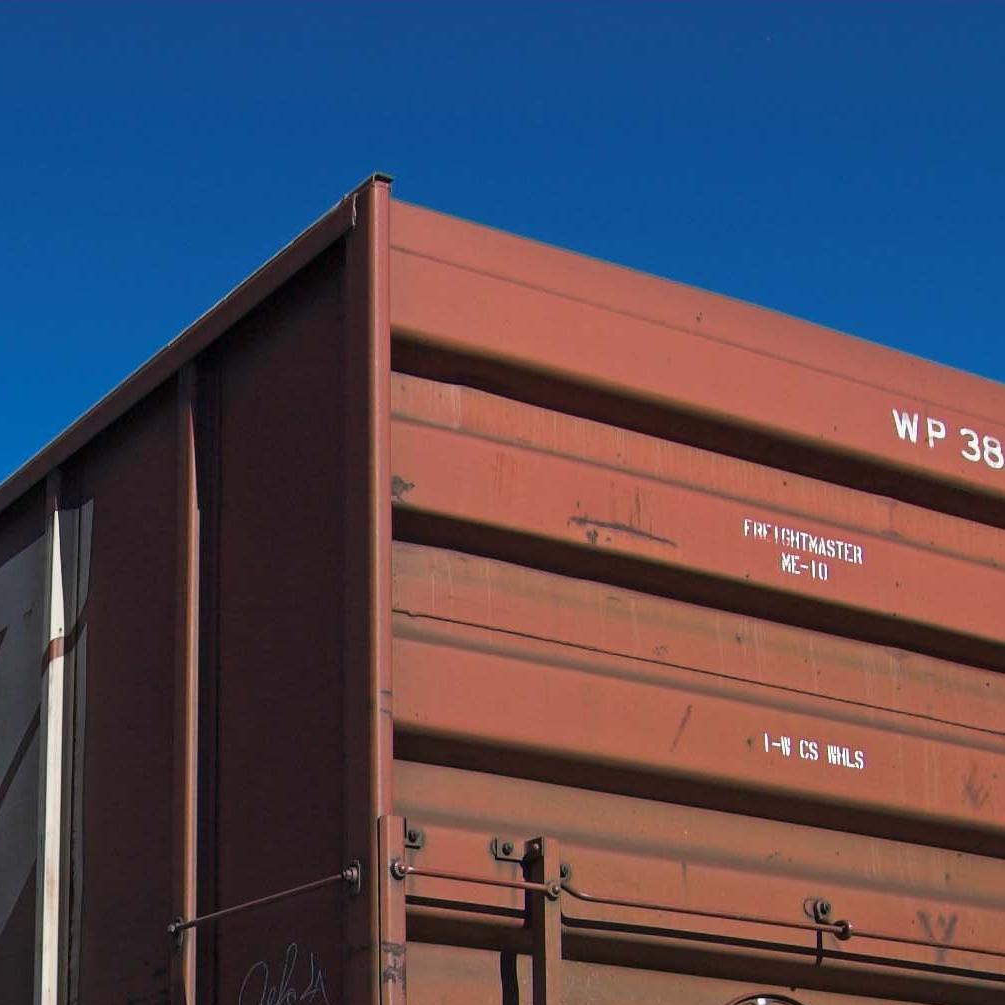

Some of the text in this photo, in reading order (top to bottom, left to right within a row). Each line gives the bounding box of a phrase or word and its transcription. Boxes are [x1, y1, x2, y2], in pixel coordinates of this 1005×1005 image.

[781, 552, 828, 581] ME-10
[799, 739, 819, 761] CS
[827, 744, 864, 769] WHLS
